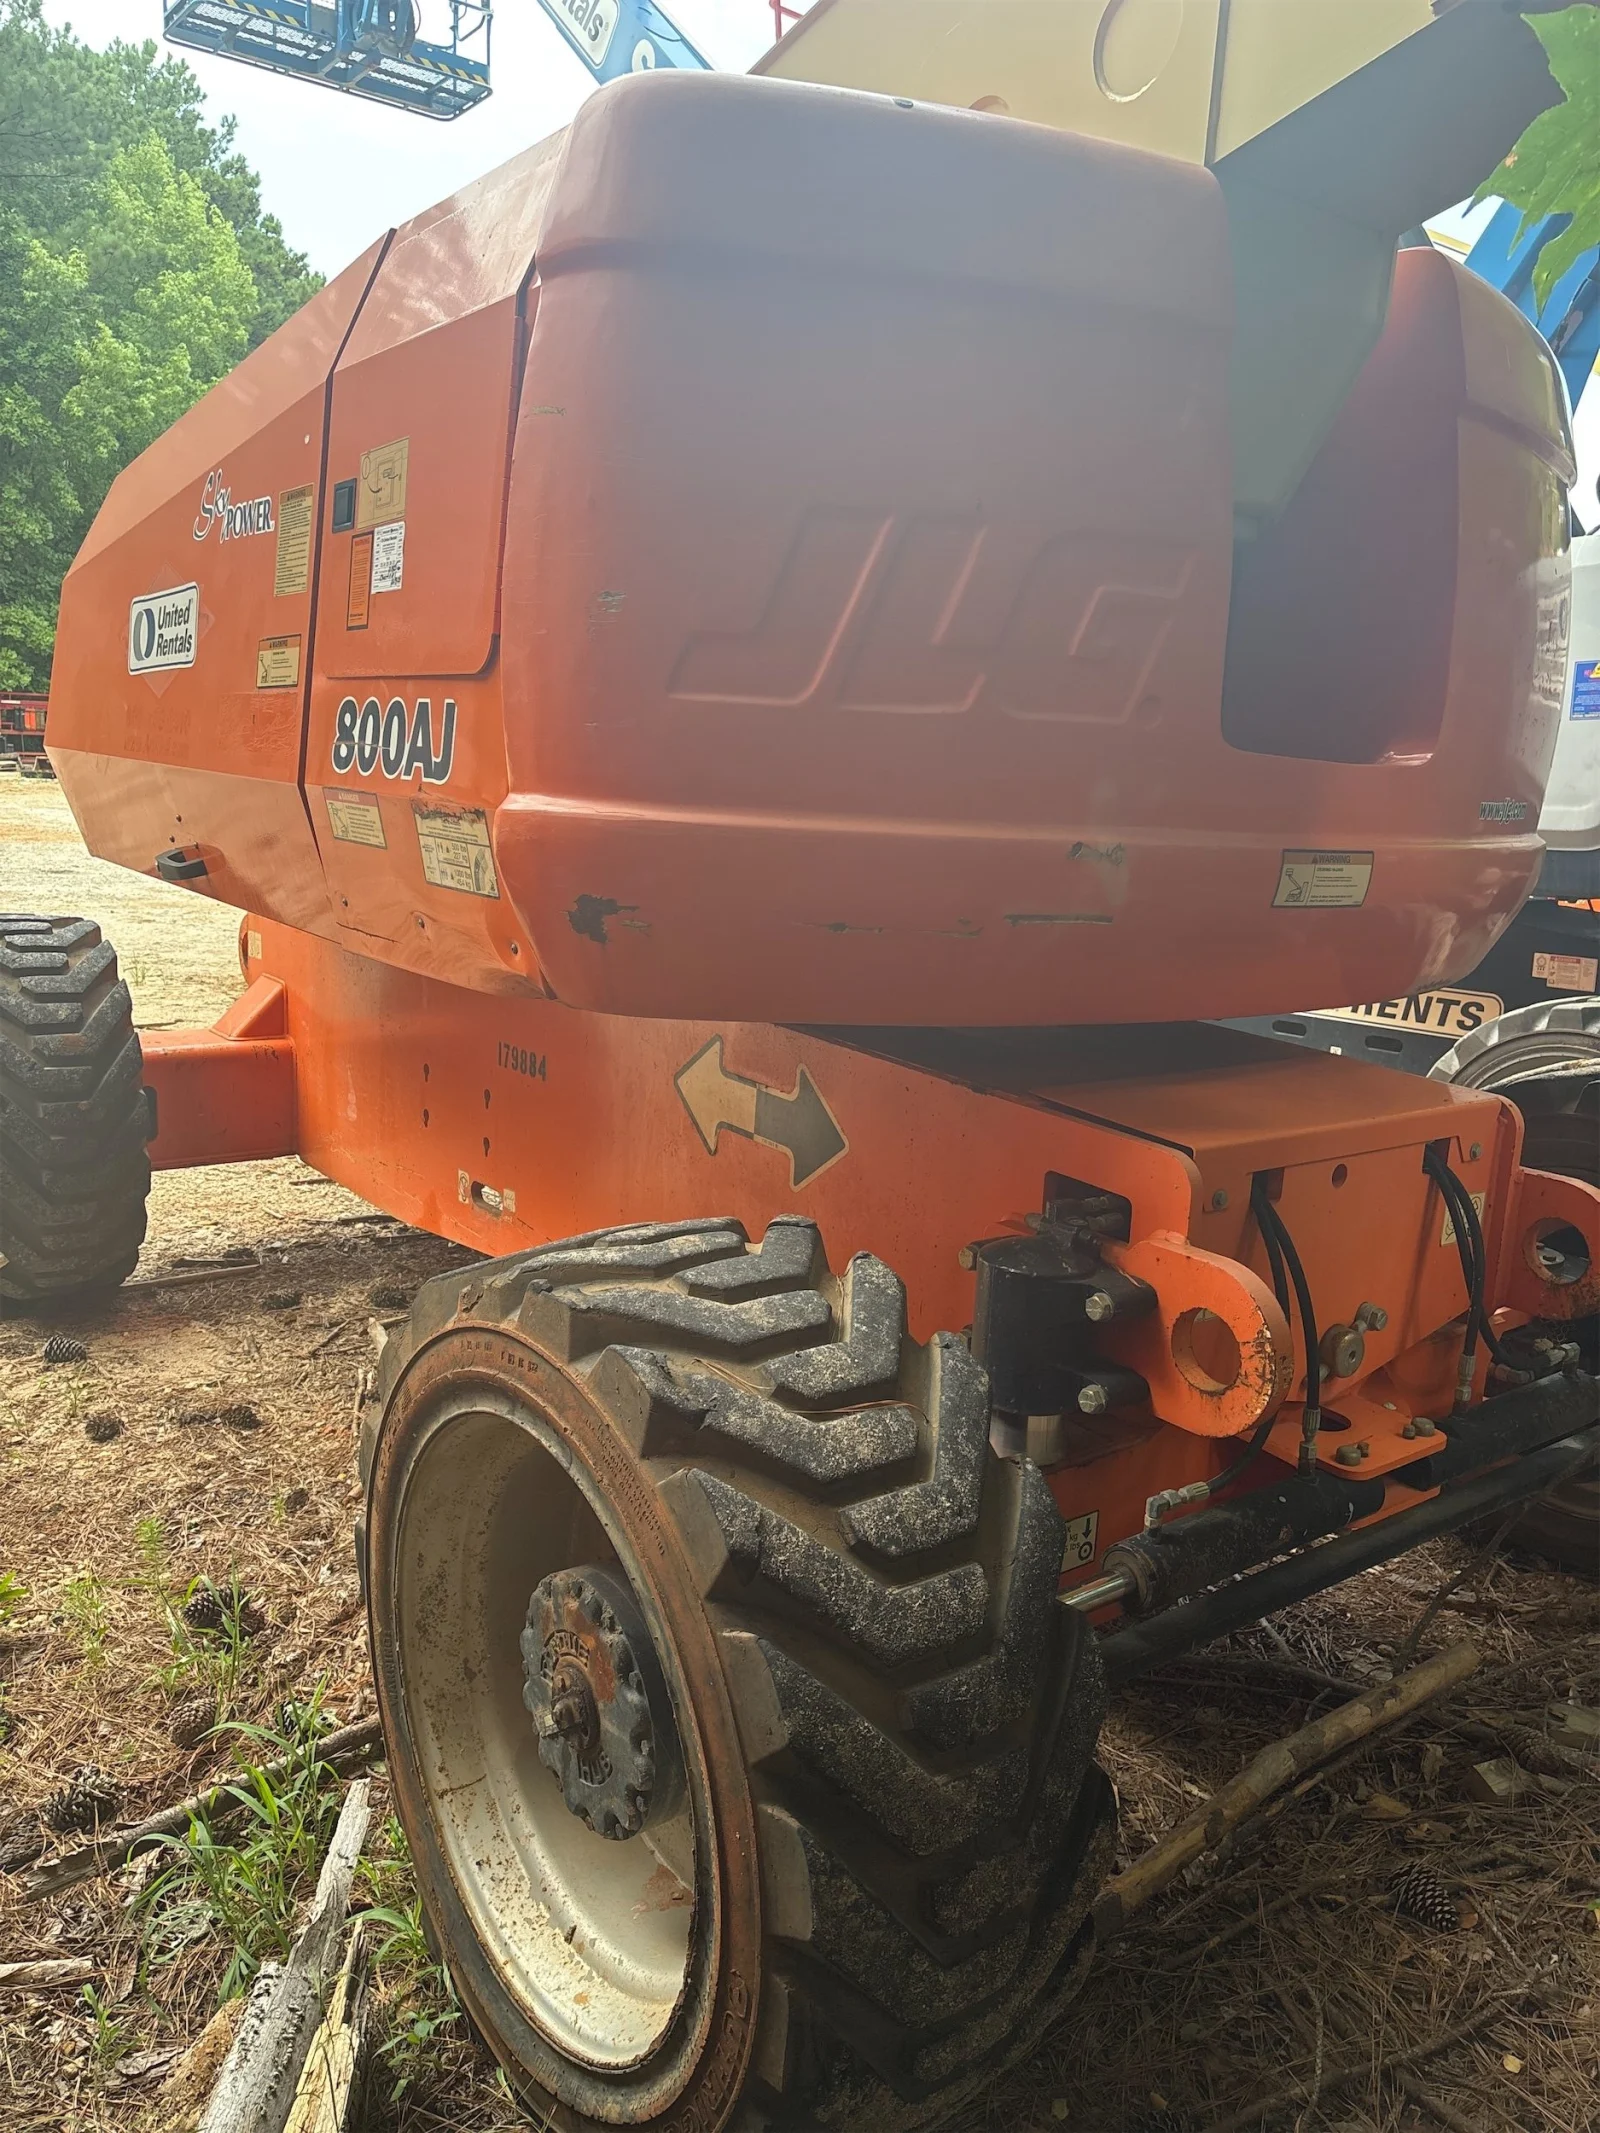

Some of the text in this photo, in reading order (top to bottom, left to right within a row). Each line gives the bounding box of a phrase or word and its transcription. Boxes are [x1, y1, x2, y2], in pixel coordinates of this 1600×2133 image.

[193, 468, 231, 543] Sky
[225, 496, 273, 539] POWER
[157, 599, 192, 630] United
[667, 506, 1199, 723] JLG
[155, 627, 193, 658] Rentals
[332, 696, 458, 785] 800AJ
[1319, 855, 1351, 864] WARNING
[498, 1041, 547, 1082] 179884
